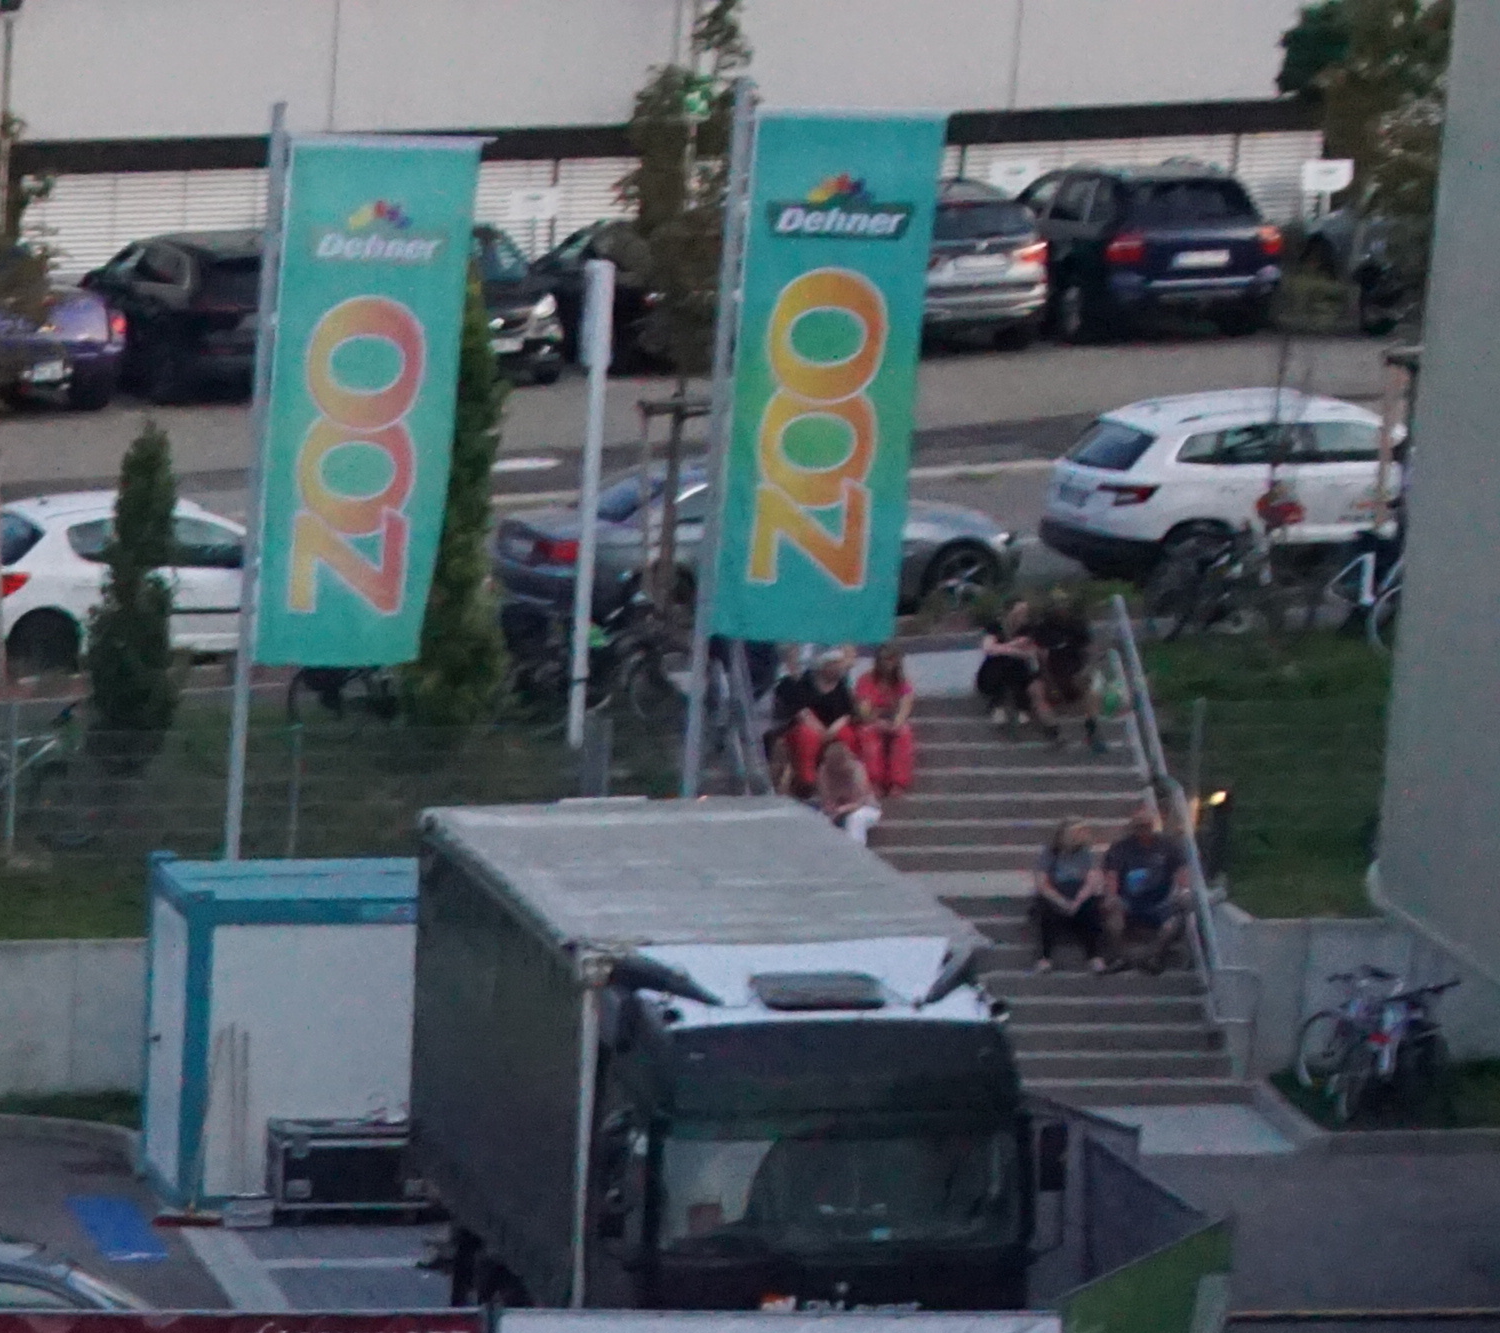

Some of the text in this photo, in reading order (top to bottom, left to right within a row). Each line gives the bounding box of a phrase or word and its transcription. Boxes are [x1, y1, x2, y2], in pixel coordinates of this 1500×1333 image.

[775, 206, 906, 236] Dehner
[288, 295, 426, 615] ZOO
[748, 266, 889, 589] ZOO
